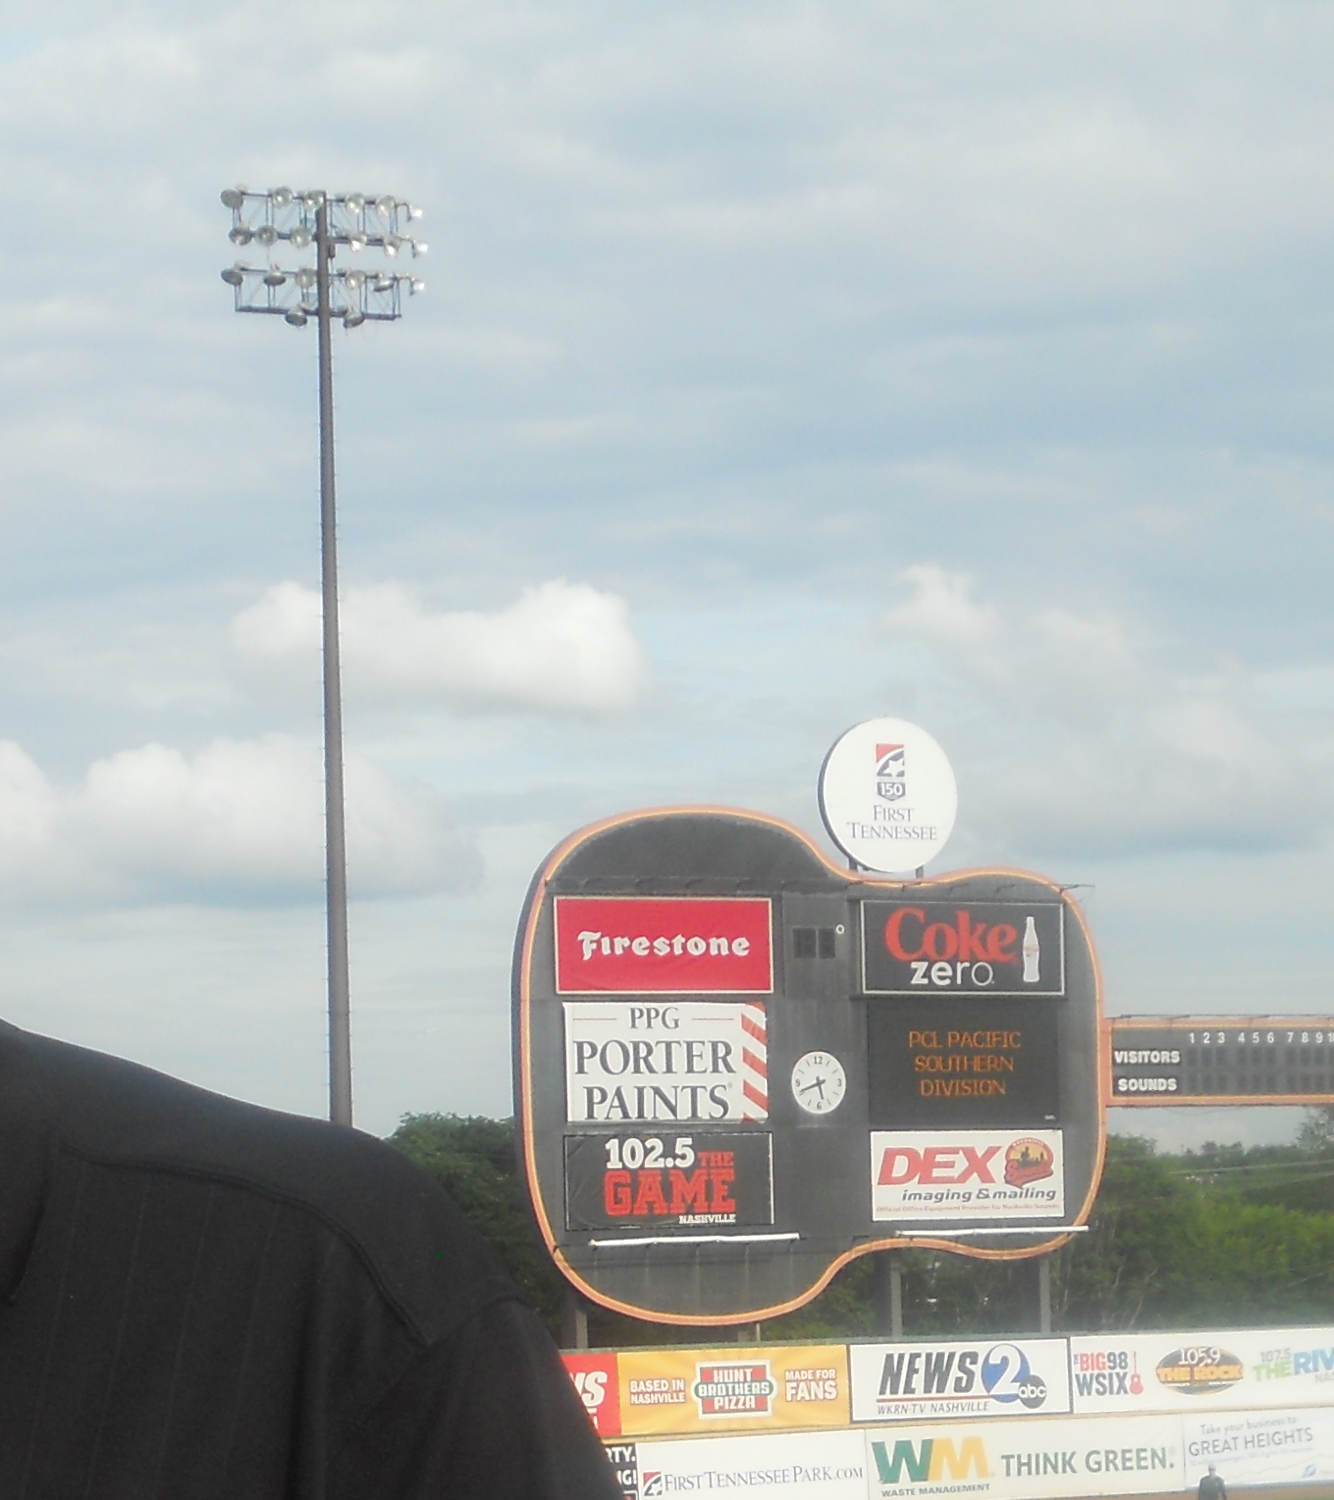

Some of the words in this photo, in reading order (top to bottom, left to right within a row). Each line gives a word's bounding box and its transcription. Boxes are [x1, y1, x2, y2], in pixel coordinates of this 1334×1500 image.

[880, 783, 903, 795] 150
[873, 805, 914, 821] FIRST
[847, 822, 937, 840] TENNESSEE
[884, 906, 1018, 963] Coke
[578, 931, 750, 960] Firestone
[910, 961, 993, 986] zero
[630, 1007, 680, 1030] PPG
[908, 1031, 942, 1048] PCL
[948, 1031, 1021, 1048] PACIFIC
[1189, 1032, 1195, 1044] 1
[1203, 1032, 1210, 1044] 2
[1218, 1032, 1225, 1044] 3
[1238, 1032, 1245, 1044] 4
[1252, 1032, 1259, 1044] 5
[1267, 1032, 1274, 1044] 6
[1287, 1032, 1294, 1044] 7
[1301, 1032, 1309, 1044] 8
[1316, 1032, 1323, 1044] 9
[573, 1040, 736, 1075] PORTER
[915, 1055, 1013, 1072] SOUTHERN
[1114, 1051, 1180, 1064] VISITORS
[921, 1080, 1006, 1096] DIVISION
[1118, 1078, 1177, 1091] SOUNDS
[583, 1084, 730, 1120] PAINTS
[605, 1138, 695, 1169] 102.5
[697, 1152, 734, 1166] THE
[877, 1146, 1002, 1185] DEX
[604, 1169, 736, 1215] GAME
[902, 1189, 972, 1203] imaging
[993, 1187, 1057, 1201] mailing
[679, 1214, 736, 1224] NASHVILLE
[1178, 1347, 1221, 1366] 105.9
[1260, 1348, 1291, 1363] 107.5
[713, 1368, 752, 1382] HUNT
[785, 1369, 814, 1380] MADE
[816, 1368, 836, 1379] FOR
[879, 1351, 979, 1396] NEWS
[988, 1344, 1023, 1396] 2
[1252, 1360, 1292, 1381] THE
[630, 1379, 668, 1394] BASED
[672, 1378, 685, 1391] IN
[698, 1381, 770, 1397] BROTHERS
[786, 1380, 838, 1402] FANS
[1018, 1382, 1047, 1398] abc
[1075, 1372, 1128, 1397] WSIX
[630, 1390, 686, 1405] NASHVILLE
[714, 1396, 756, 1410] PIZZA
[877, 1402, 926, 1415] WKRN-TV
[930, 1400, 989, 1413] NASHVILLE
[1200, 1423, 1221, 1436] Take
[1224, 1423, 1244, 1436] your
[1247, 1417, 1286, 1430] business
[1188, 1436, 1239, 1457] GREAT
[1244, 1426, 1314, 1450] HEIGHTS
[871, 1436, 990, 1485] WM
[1001, 1451, 1078, 1477] THINK
[1085, 1447, 1175, 1473] GREEN.
[882, 1488, 915, 1498] WASTE
[919, 1483, 990, 1496] MANAGEMENT
